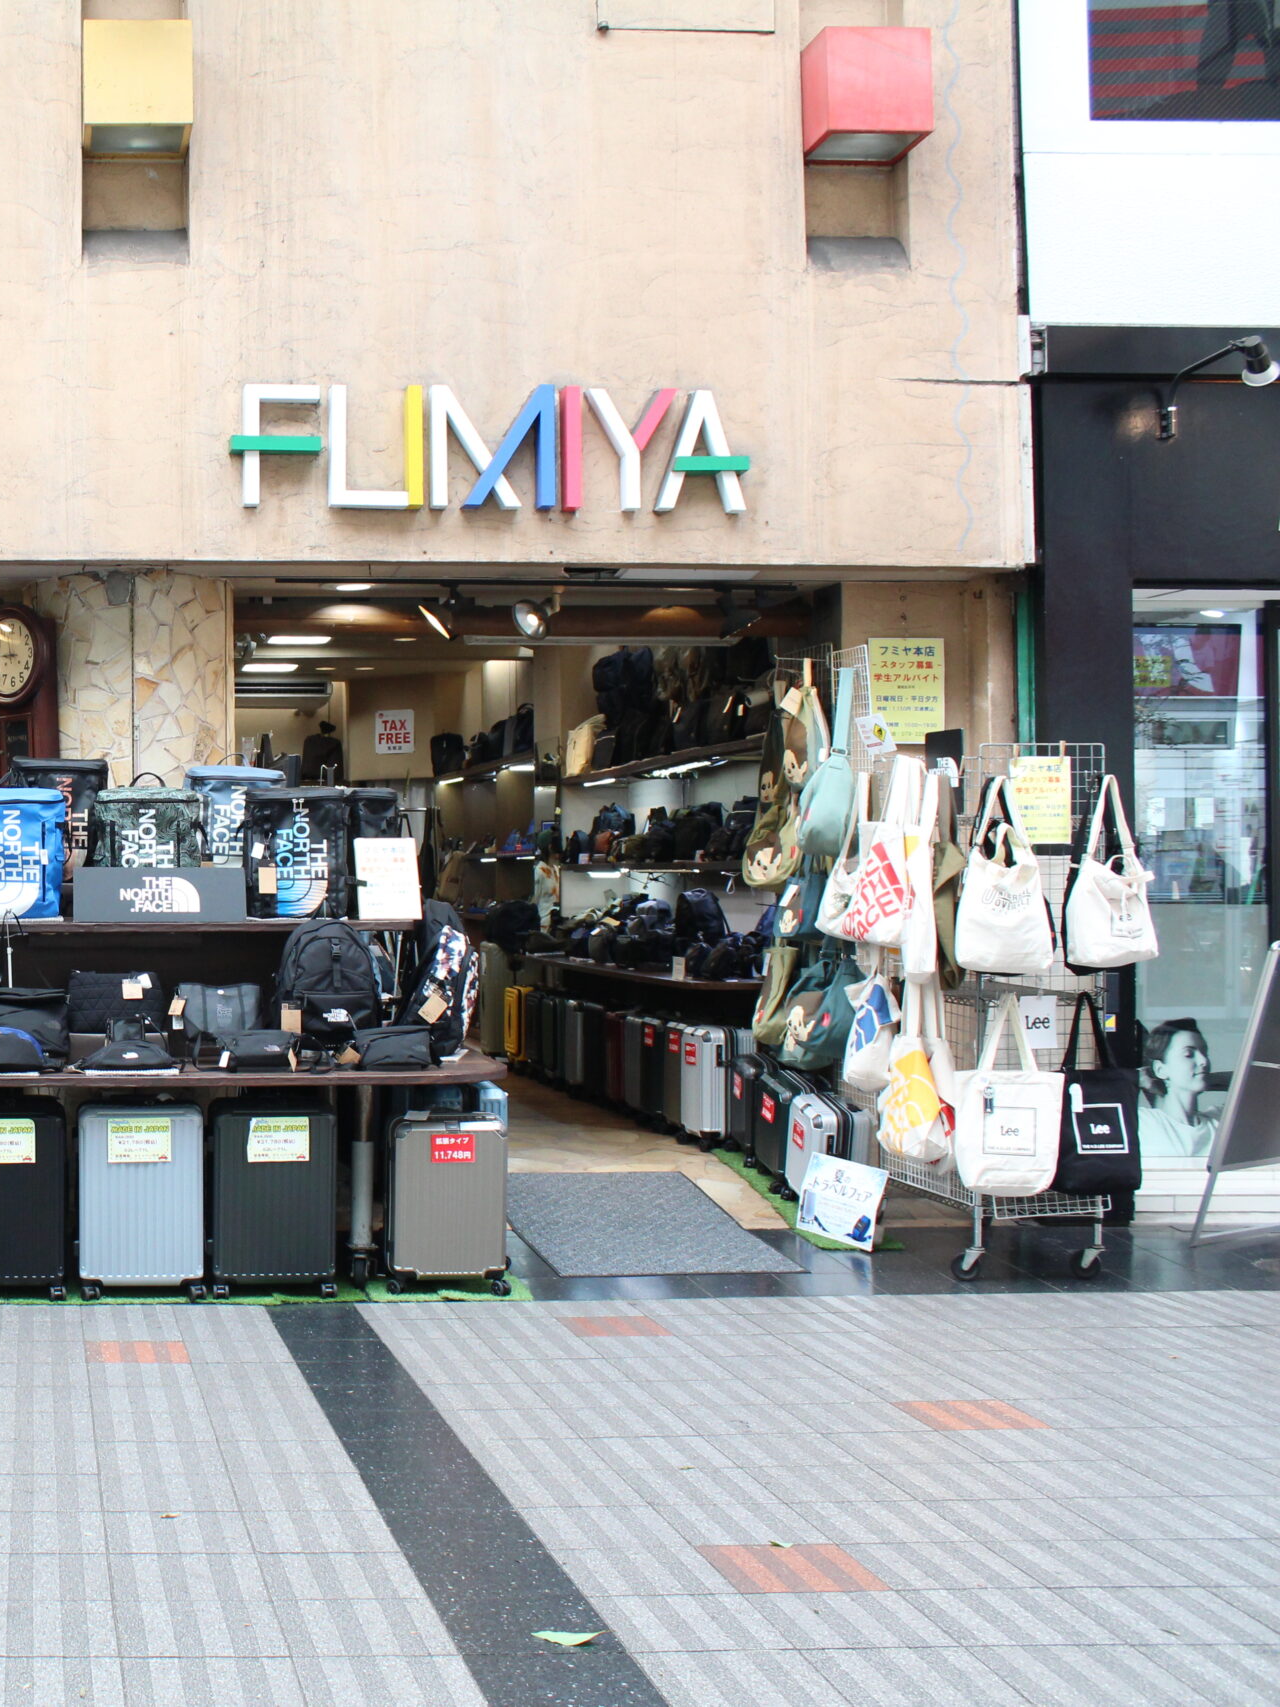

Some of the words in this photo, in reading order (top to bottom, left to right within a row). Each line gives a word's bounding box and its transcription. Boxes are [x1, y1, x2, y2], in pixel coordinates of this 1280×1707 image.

[378, 732, 411, 744] FREE
[381, 720, 407, 731] TAX
[3, 809, 23, 881] NORTH
[72, 808, 88, 848] THE
[138, 808, 157, 868] NORT
[212, 804, 231, 856] FACE
[293, 807, 311, 879] NORTH
[22, 841, 40, 882] THE
[121, 829, 140, 868] FAC
[156, 840, 174, 868] TH
[276, 828, 293, 879] FACE
[311, 839, 328, 879] THE
[119, 888, 173, 901] NORTH
[142, 876, 173, 889] THE
[1025, 1016, 1050, 1030] Lee
[1001, 1125, 1020, 1136] Lee
[1089, 1123, 1111, 1134] Lee
